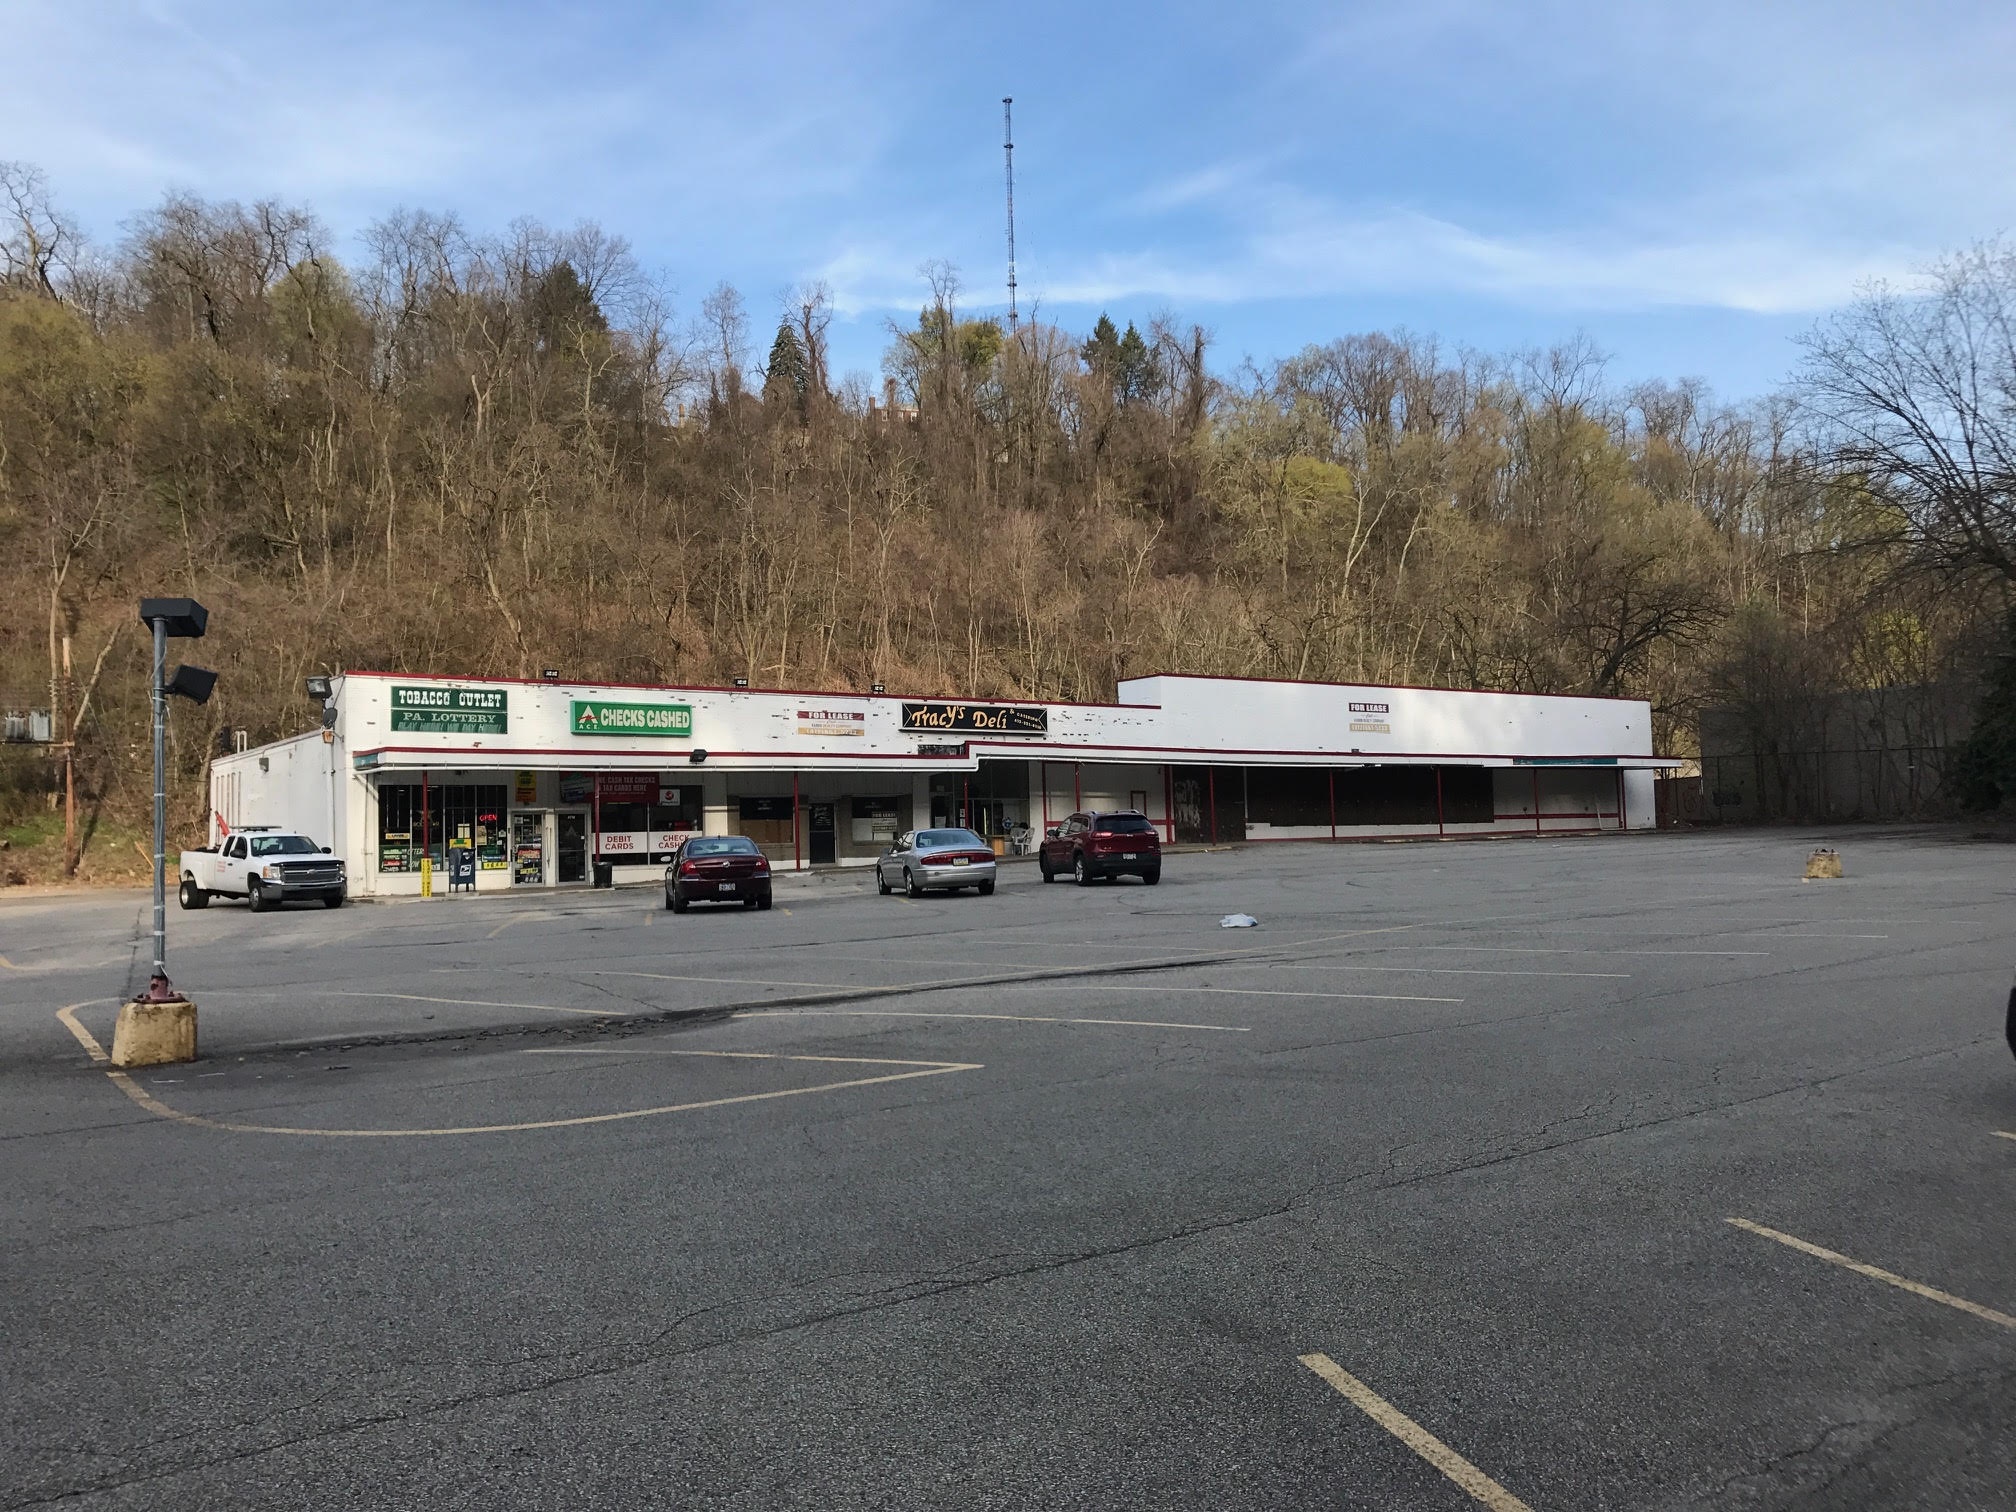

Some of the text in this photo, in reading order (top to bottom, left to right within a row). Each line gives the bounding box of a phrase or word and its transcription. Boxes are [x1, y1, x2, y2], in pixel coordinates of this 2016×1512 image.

[398, 690, 502, 708] TOBACCO OUTLET
[1350, 703, 1387, 713] FOR LEASE
[403, 712, 497, 723] PA. LOTTERY
[600, 708, 690, 729] CHECKS CASHED
[808, 712, 826, 720] FOR
[911, 705, 966, 730] Tracy's
[972, 709, 1007, 730] Deli
[479, 813, 497, 822] OPEN
[606, 835, 632, 843] DEBIT
[662, 834, 690, 842] CHECK
[604, 842, 634, 850] CARDS
